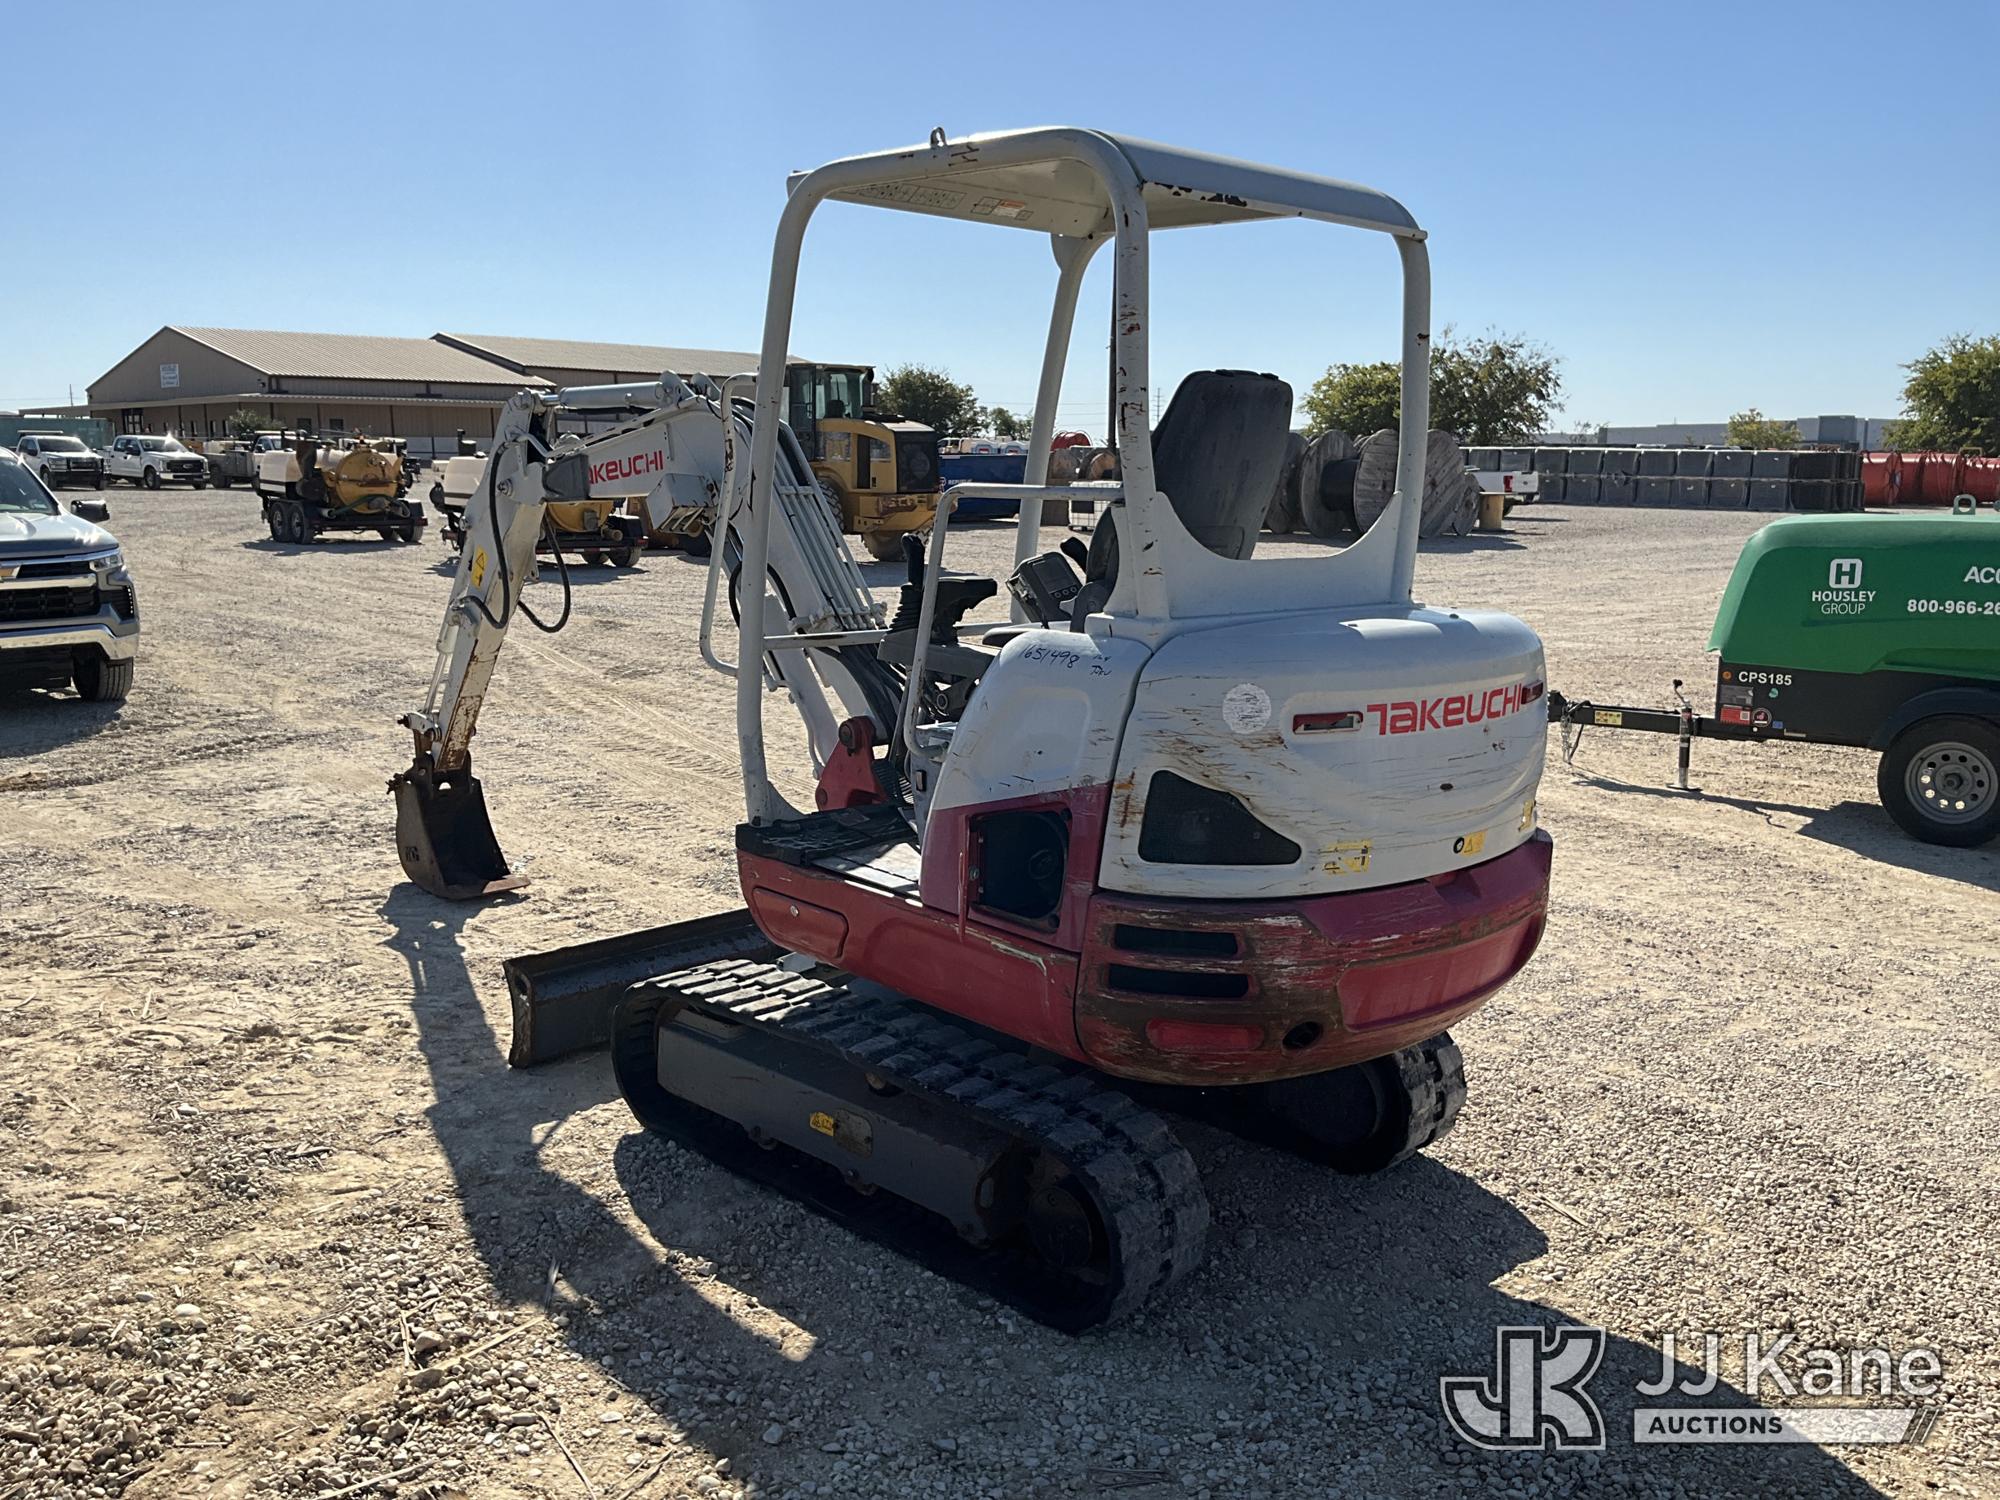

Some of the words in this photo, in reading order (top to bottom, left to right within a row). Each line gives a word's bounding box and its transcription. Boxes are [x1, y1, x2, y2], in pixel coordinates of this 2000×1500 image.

[589, 450, 664, 485] KEUCHI
[1812, 590, 1877, 602] HOUSLEY
[1821, 603, 1866, 615] GROUP
[1738, 671, 1792, 686] CPS185
[1366, 683, 1522, 736] TAKEUCHI
